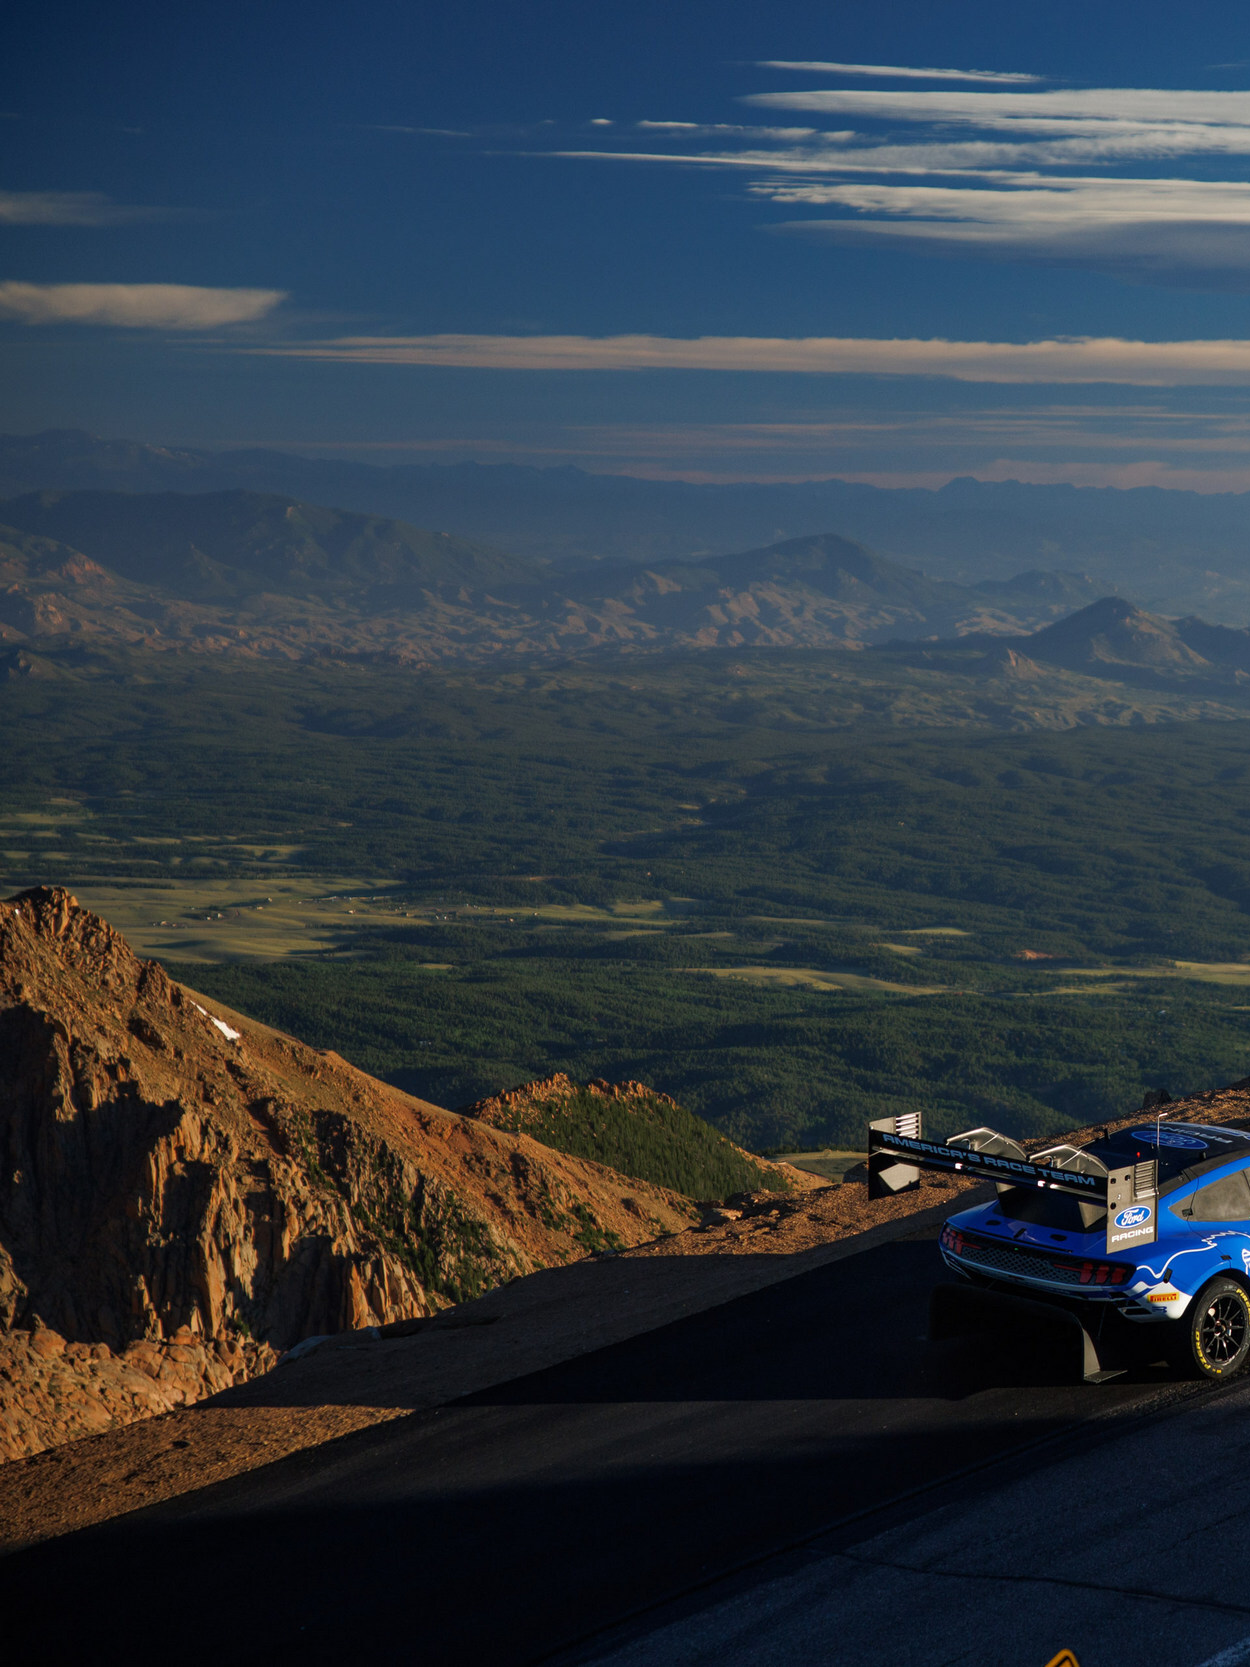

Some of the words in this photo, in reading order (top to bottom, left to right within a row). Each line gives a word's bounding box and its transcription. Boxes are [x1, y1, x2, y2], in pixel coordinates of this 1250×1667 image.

[882, 1133, 982, 1164] AMERICA'S
[984, 1156, 1037, 1175] RACE
[1037, 1167, 1096, 1187] TEAM
[1120, 1208, 1145, 1226] Ford
[1111, 1226, 1154, 1243] RACING
[1150, 1293, 1177, 1303] PIRELLI
